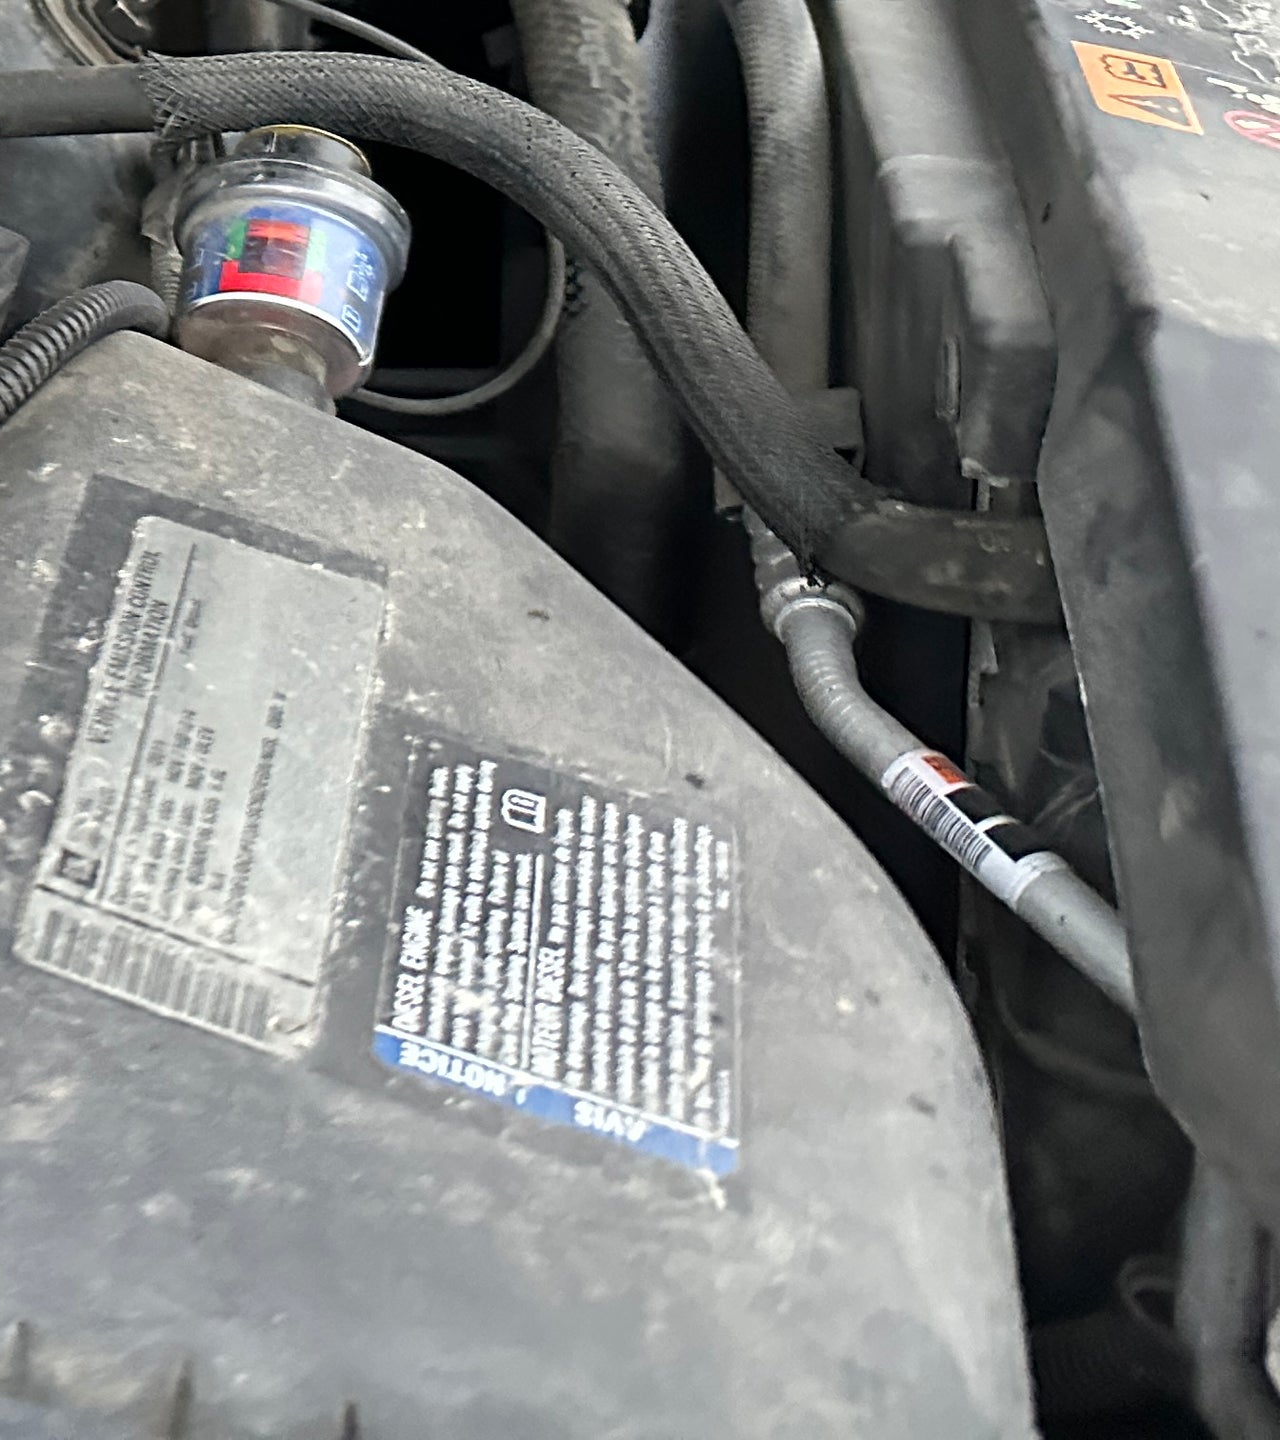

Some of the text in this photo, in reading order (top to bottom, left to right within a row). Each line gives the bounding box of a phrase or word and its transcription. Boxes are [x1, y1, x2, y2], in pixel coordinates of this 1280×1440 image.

[111, 611, 136, 680] EMISSION
[131, 549, 156, 607] CONTROL
[132, 599, 162, 697] INFORMATION
[401, 905, 430, 969] ENGINE
[393, 969, 423, 1031] DIESEL
[399, 1041, 507, 1096] NOTICE
